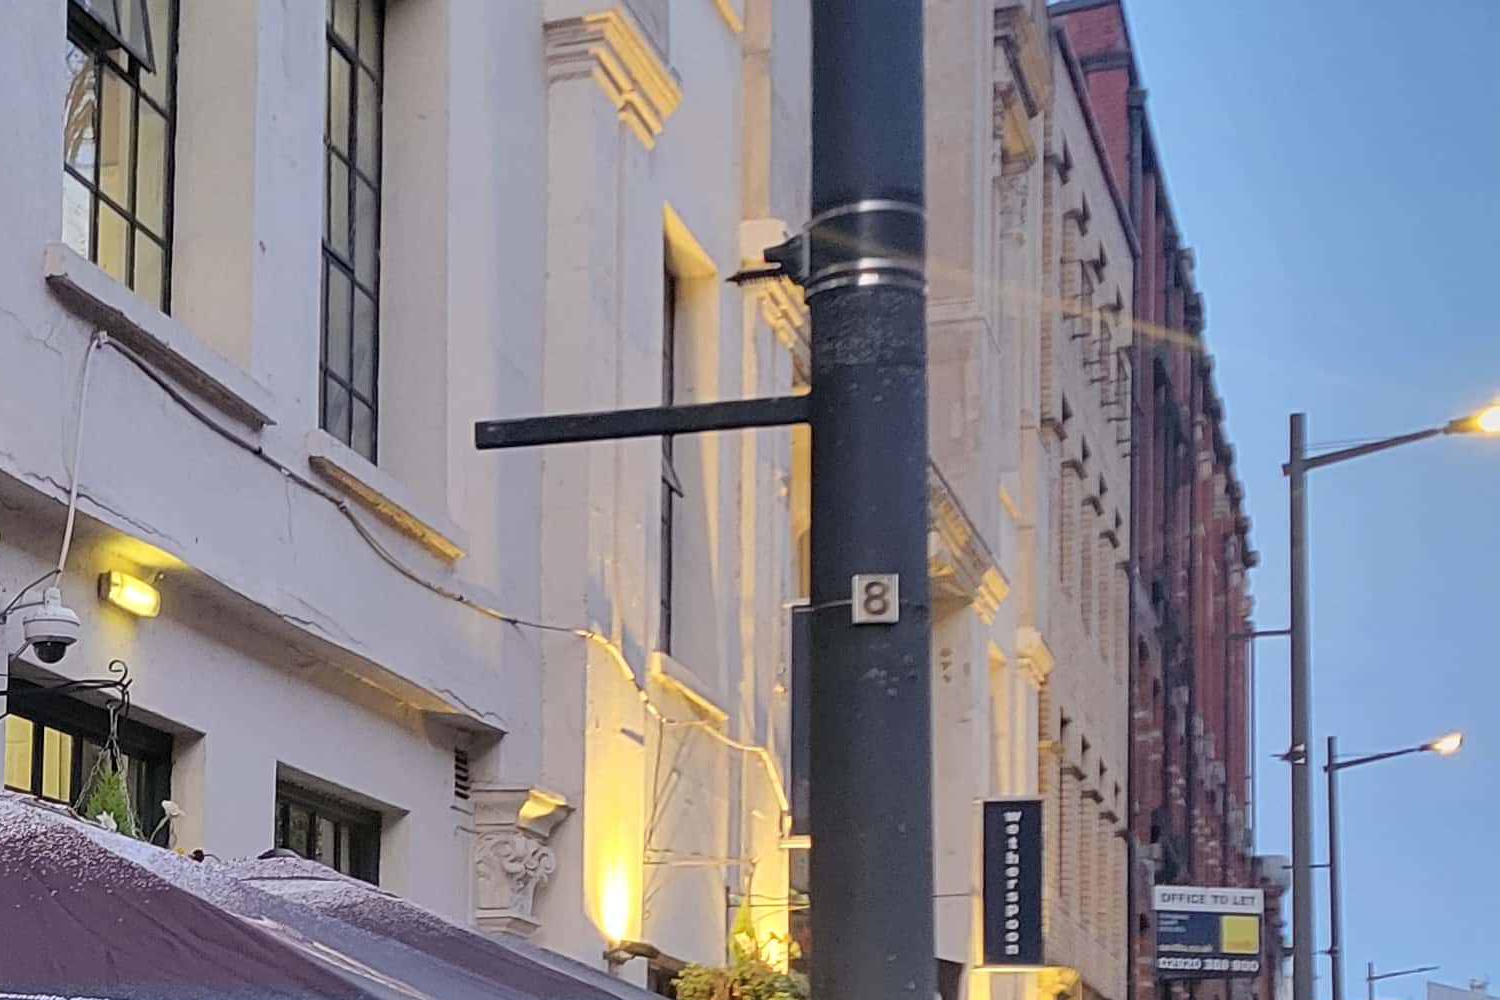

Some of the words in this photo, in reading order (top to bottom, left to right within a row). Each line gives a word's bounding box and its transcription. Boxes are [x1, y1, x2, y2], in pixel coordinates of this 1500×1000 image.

[863, 581, 890, 615] 8
[1160, 892, 1205, 905] OFFICE
[1211, 894, 1229, 906] TO
[1232, 895, 1256, 907] LET
